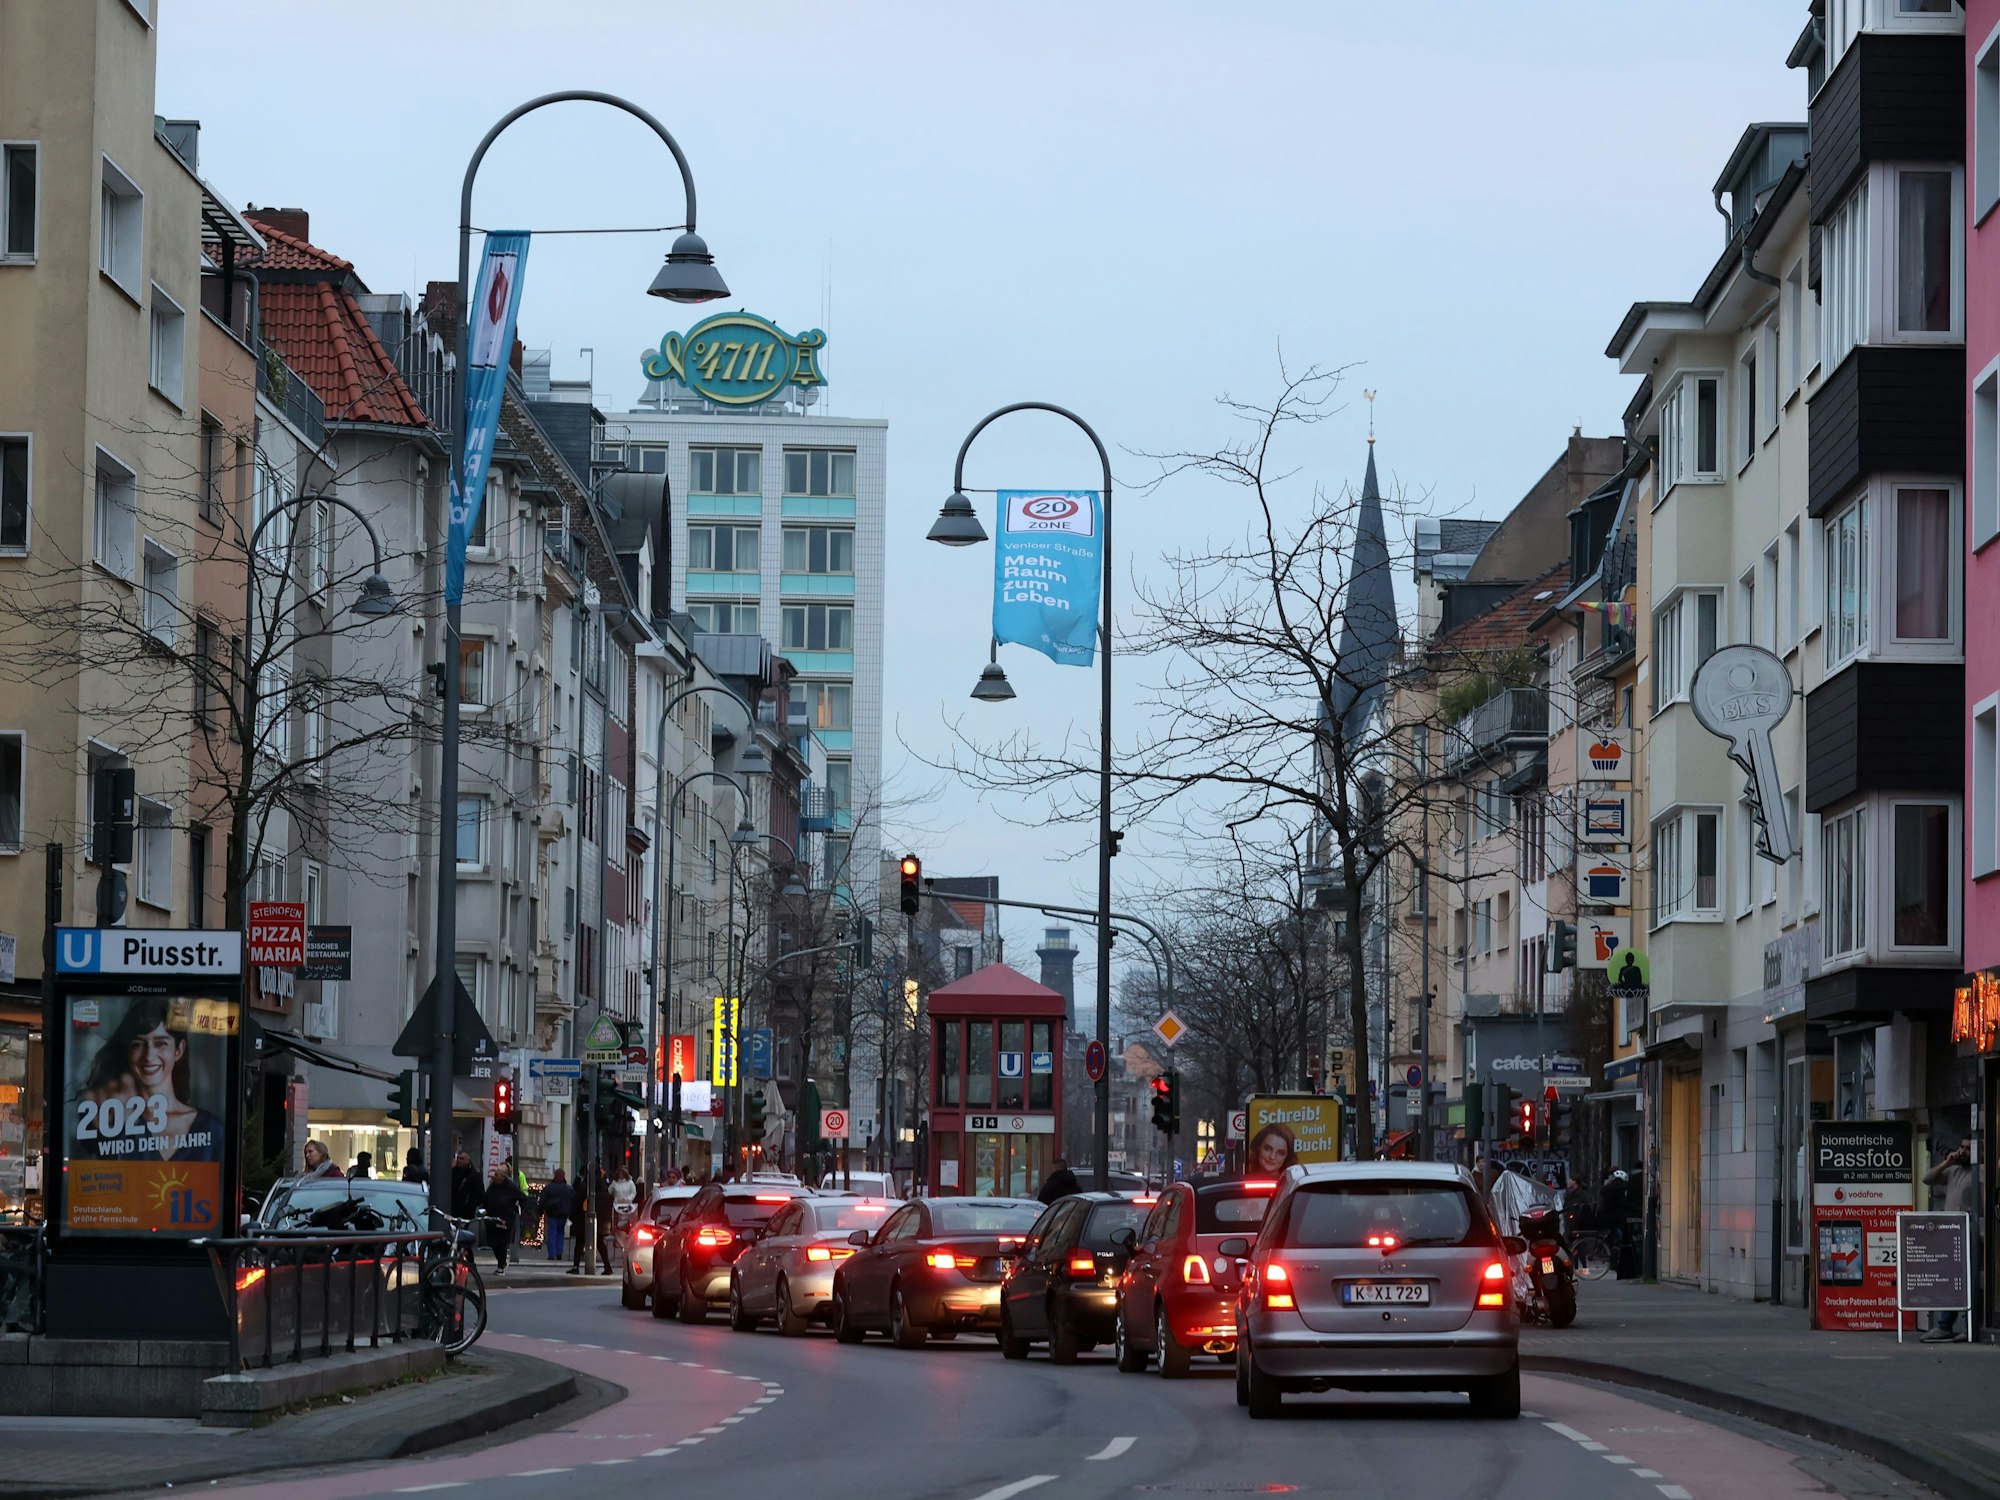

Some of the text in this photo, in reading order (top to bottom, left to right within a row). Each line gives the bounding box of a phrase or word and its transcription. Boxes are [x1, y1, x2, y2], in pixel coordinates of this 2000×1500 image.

[1035, 501, 1067, 514] 20
[1028, 521, 1072, 530] ZONE
[1004, 543, 1094, 558] Venloer Straße
[1004, 555, 1062, 569] Mehr
[1004, 567, 1067, 584] Raum
[1003, 579, 1049, 592] zum
[1003, 591, 1070, 610] Leben
[1721, 695, 1771, 720] BKS
[252, 906, 302, 919] STEINOFEN
[251, 926, 302, 942] PIZZA
[63, 933, 223, 968] U Piusstr.
[250, 946, 302, 962] MARIA
[307, 950, 350, 959] RESTAURANT
[127, 985, 167, 993] JCDecaux
[1000, 1054, 1021, 1076] U
[76, 1094, 168, 1141] 2023
[829, 1116, 841, 1126] 20
[1258, 1105, 1321, 1124] Schreib!
[974, 1118, 996, 1127] 3 4
[1302, 1125, 1326, 1136] Dein!
[98, 1131, 212, 1156] WIRD DEIN JAHR!
[1293, 1136, 1332, 1152] Buch!
[1821, 1134, 1894, 1146] biometrische
[1820, 1148, 1903, 1167] Passfoto
[1894, 1171, 1912, 1181] Shop
[73, 1205, 122, 1214] Deutschlands
[169, 1188, 212, 1224] ils
[1816, 1207, 1844, 1217] Display
[1844, 1207, 1876, 1216] Wechsel
[73, 1215, 139, 1224] größte Fernschule
[1868, 1219, 1879, 1227] 15
[1877, 1279, 1892, 1287] Köln
[1355, 1286, 1423, 1300] K XI 729
[1849, 1297, 1878, 1306] Patronen
[1859, 1320, 1883, 1328] Handys
